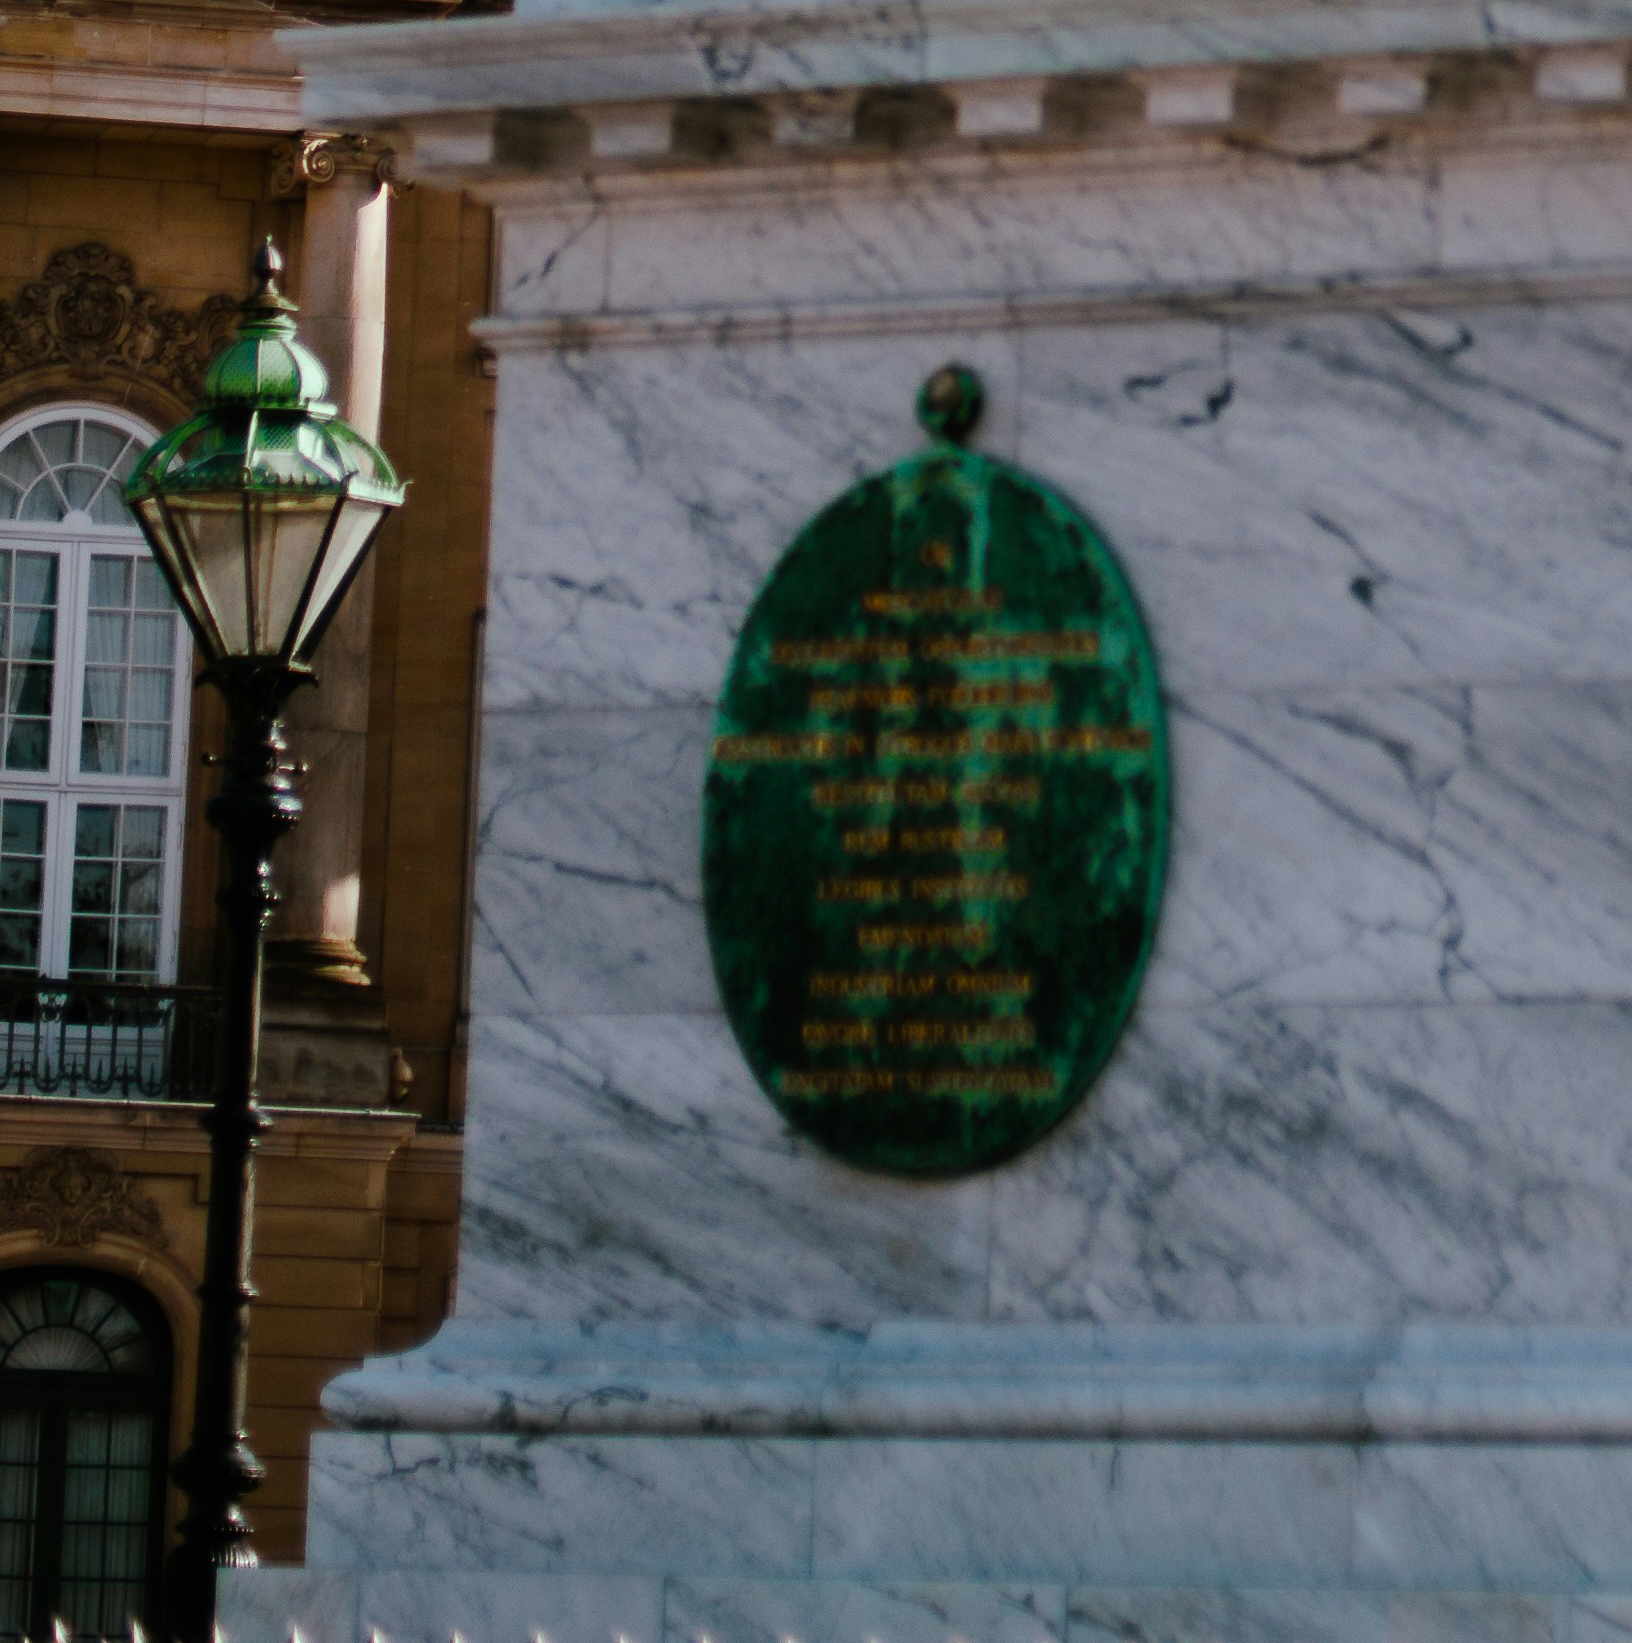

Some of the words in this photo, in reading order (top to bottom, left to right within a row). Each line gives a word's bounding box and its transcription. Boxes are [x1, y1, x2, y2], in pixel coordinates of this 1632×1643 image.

[816, 878, 900, 902] LEGIBUS
[810, 972, 936, 997] INDUSTRIAM
[781, 1070, 894, 1095] EXCITATAM
